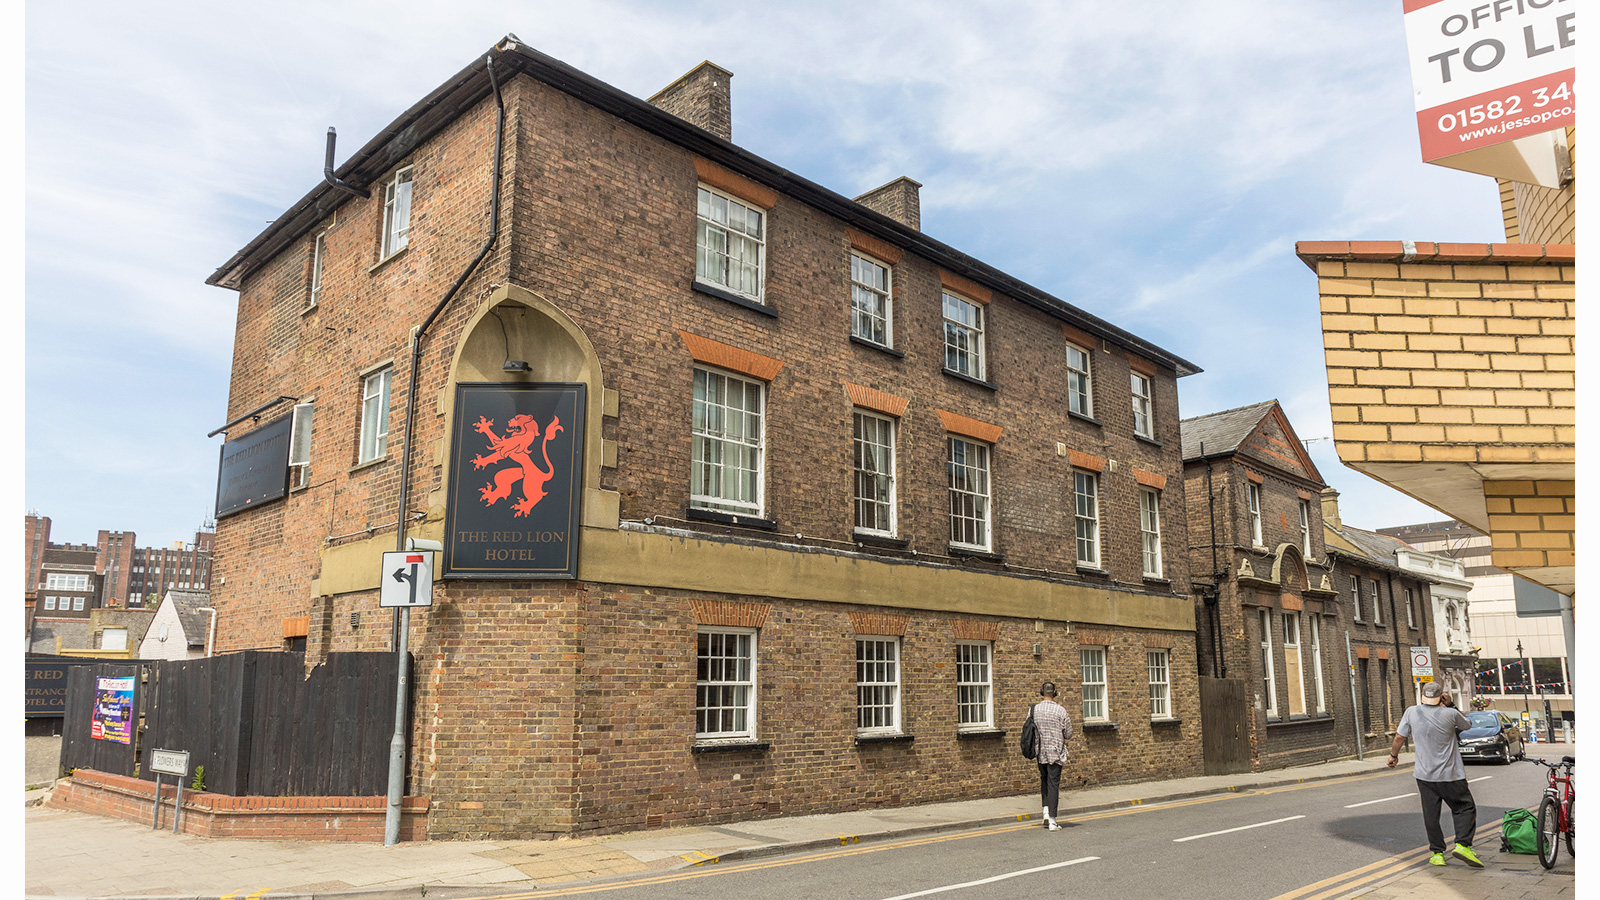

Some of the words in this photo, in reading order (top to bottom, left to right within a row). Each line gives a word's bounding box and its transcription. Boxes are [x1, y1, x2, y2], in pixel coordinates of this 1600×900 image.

[1441, 0, 1567, 37] OFFI
[1428, 38, 1506, 84] TO
[1523, 12, 1575, 58] LE
[1437, 95, 1523, 133] 01582
[1532, 81, 1575, 107] 34
[459, 531, 489, 543] THE
[492, 531, 523, 543] RED
[527, 531, 565, 543] LION
[485, 549, 536, 561] HOTEL
[34, 670, 63, 680] RED
[50, 698, 65, 706] CA
[156, 755, 175, 767] FLOWERS
